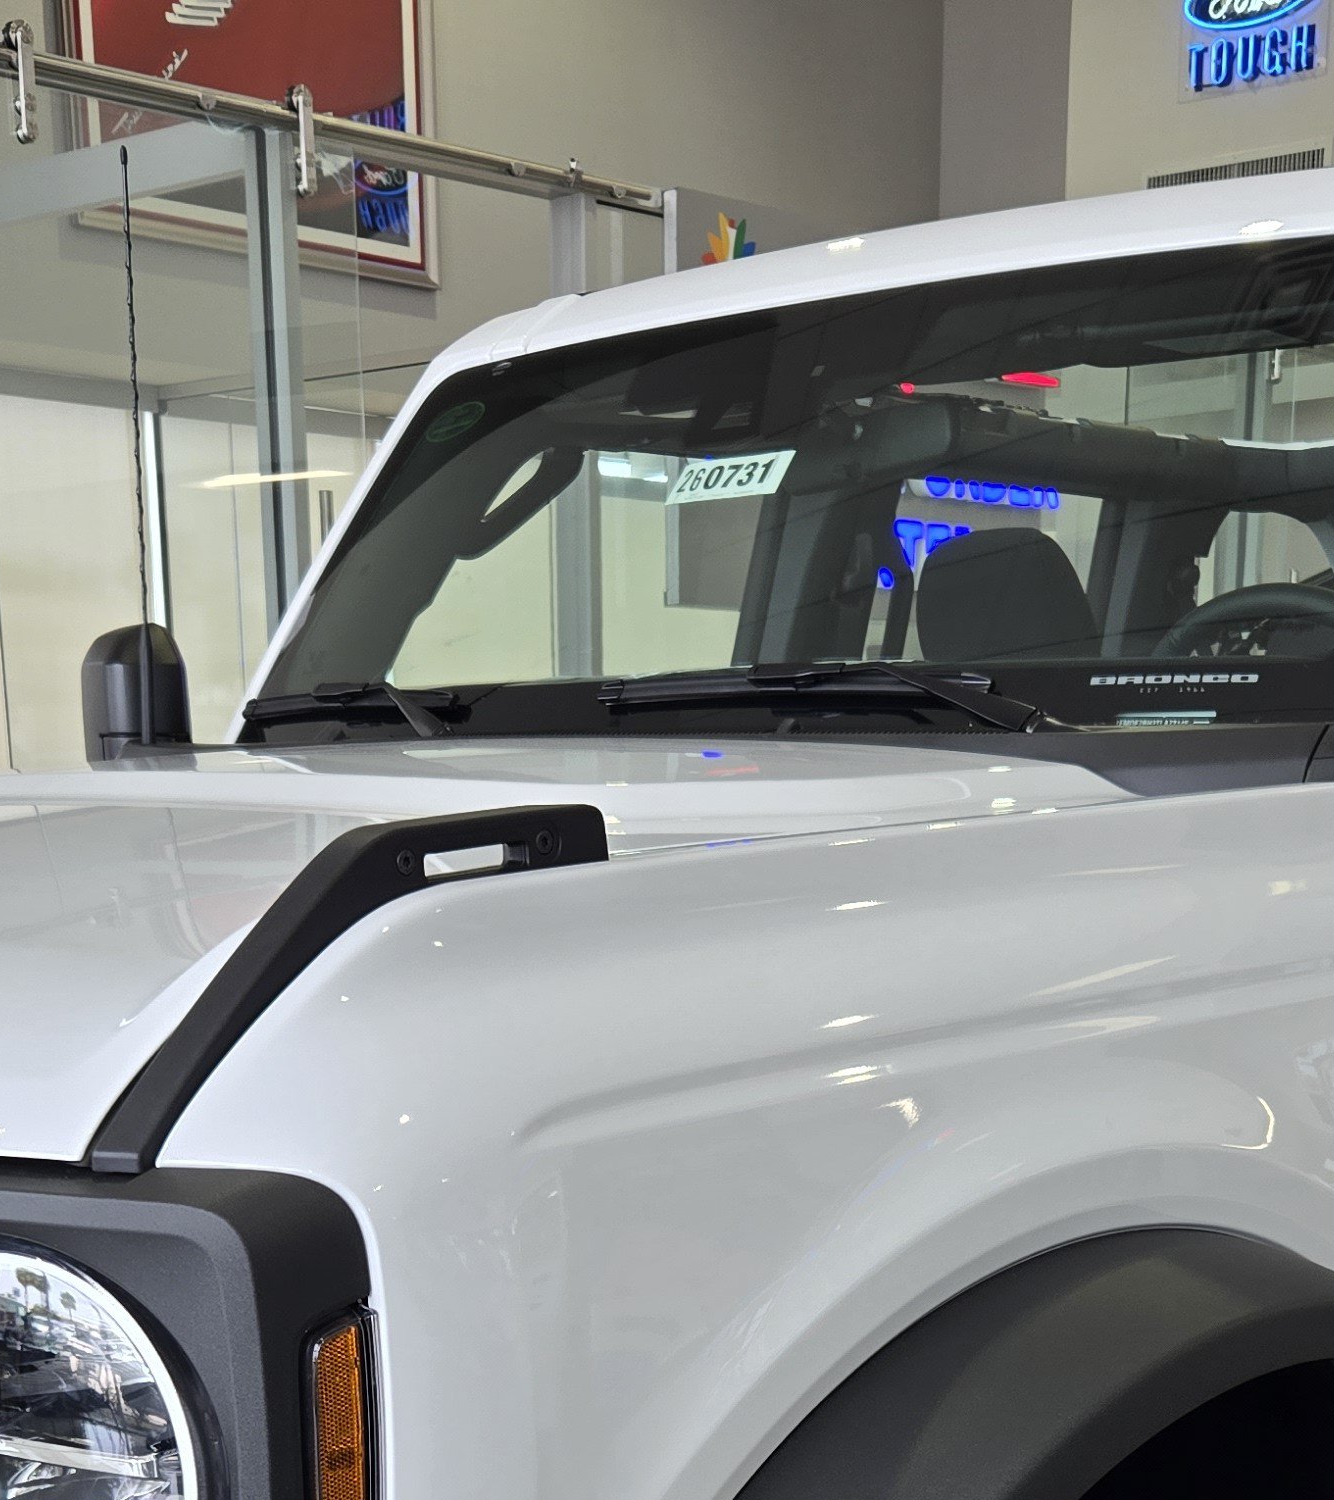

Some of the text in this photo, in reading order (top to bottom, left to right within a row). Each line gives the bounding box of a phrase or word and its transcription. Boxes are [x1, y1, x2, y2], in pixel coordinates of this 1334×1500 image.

[1188, 23, 1317, 92] TOUGH
[676, 458, 776, 493] 260731
[1089, 674, 1259, 686] BRONCO
